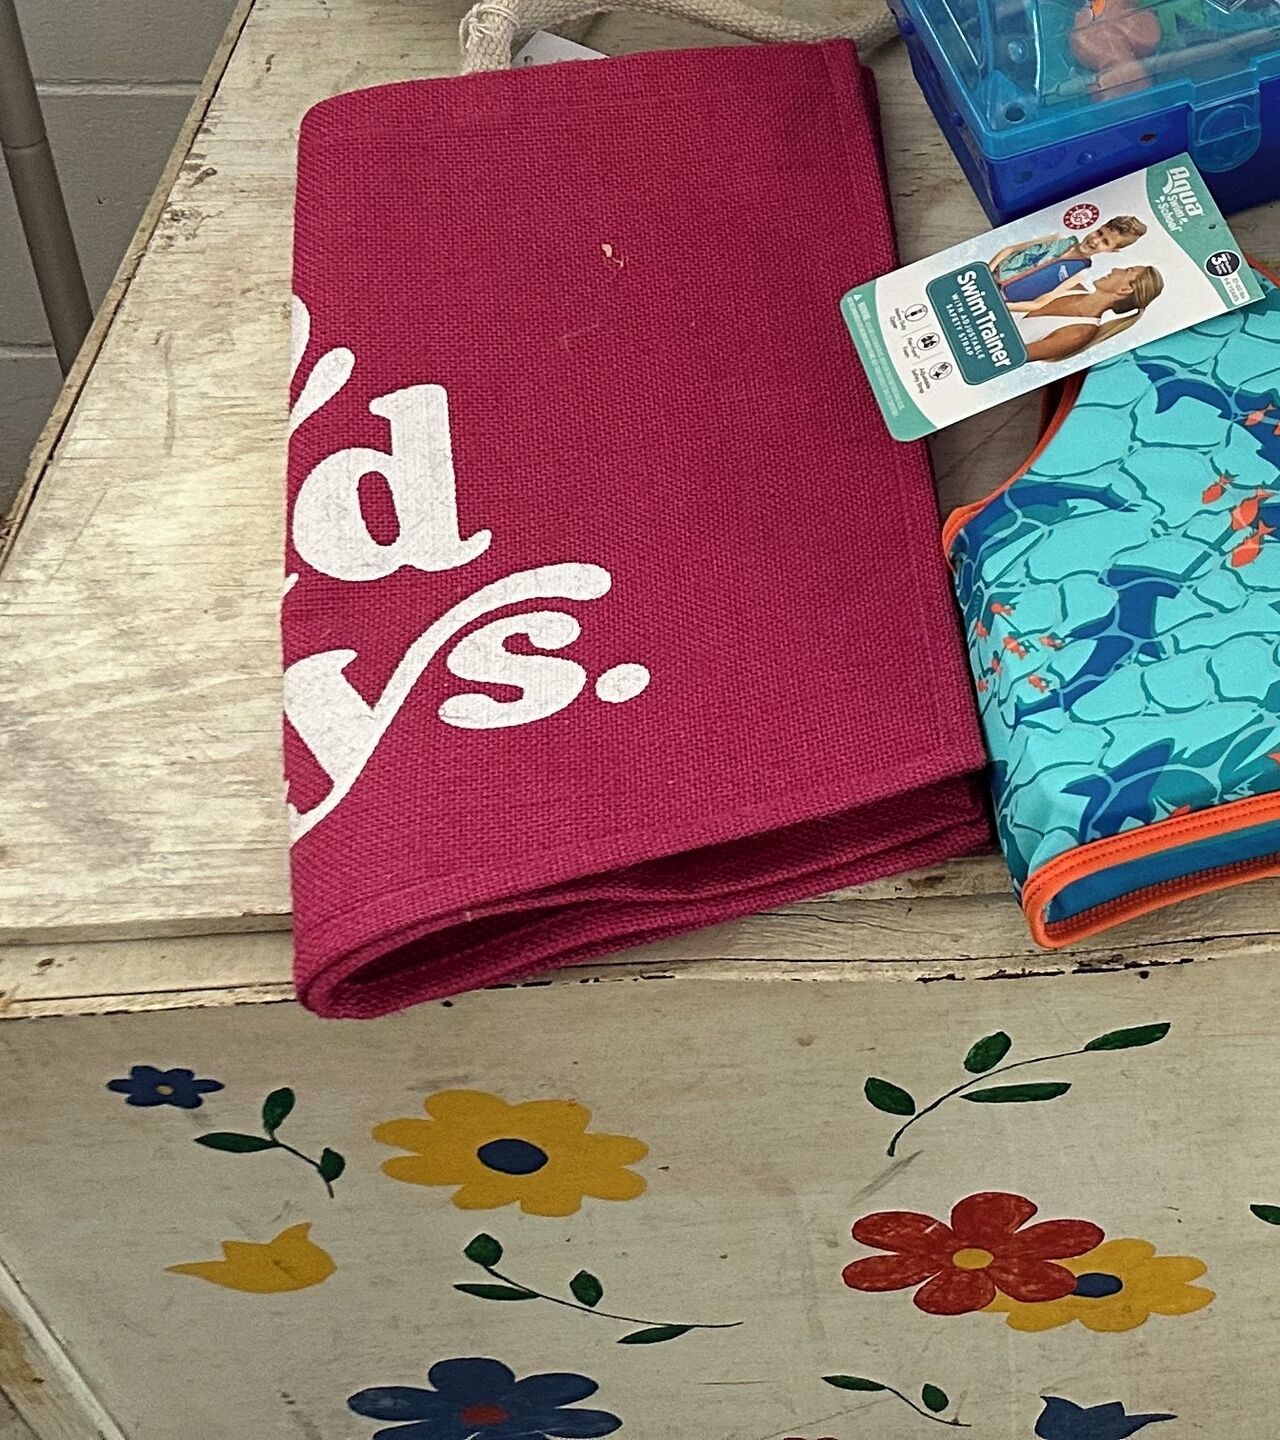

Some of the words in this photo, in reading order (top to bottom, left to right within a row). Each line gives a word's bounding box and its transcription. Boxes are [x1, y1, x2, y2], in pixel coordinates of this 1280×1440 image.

[1166, 166, 1203, 217] Aqua
[1167, 194, 1184, 218] Swim
[1159, 203, 1180, 232] School
[1211, 253, 1228, 265] 3
[946, 303, 963, 331] SAFETY
[958, 332, 974, 356] STRAP
[952, 293, 964, 313] WITH
[960, 314, 985, 359] ADJUSTABLE
[957, 270, 987, 317] Swim
[976, 310, 1011, 367] Trainer
